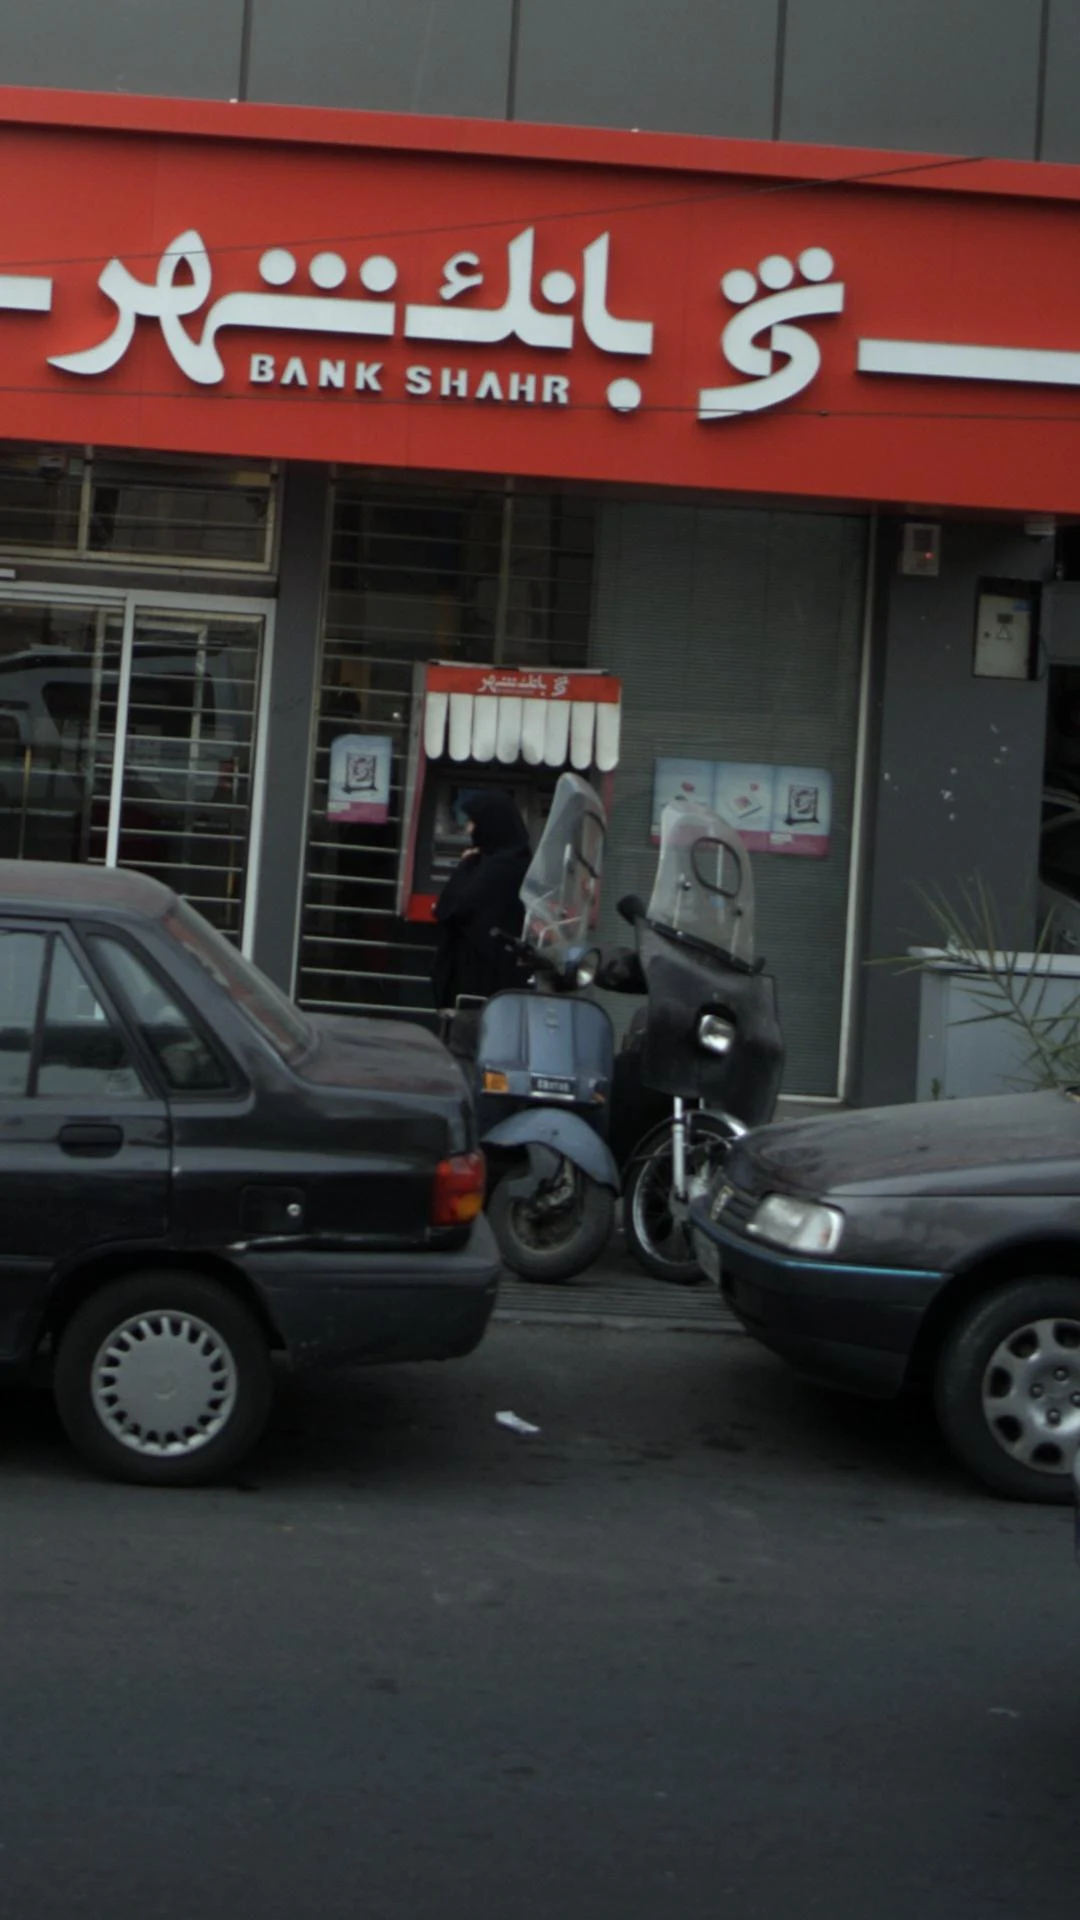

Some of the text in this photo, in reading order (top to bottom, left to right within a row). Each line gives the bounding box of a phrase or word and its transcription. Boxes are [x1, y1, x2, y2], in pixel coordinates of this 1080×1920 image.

[46, 229, 397, 385] شهر
[248, 353, 571, 406] BANK SHAHR
